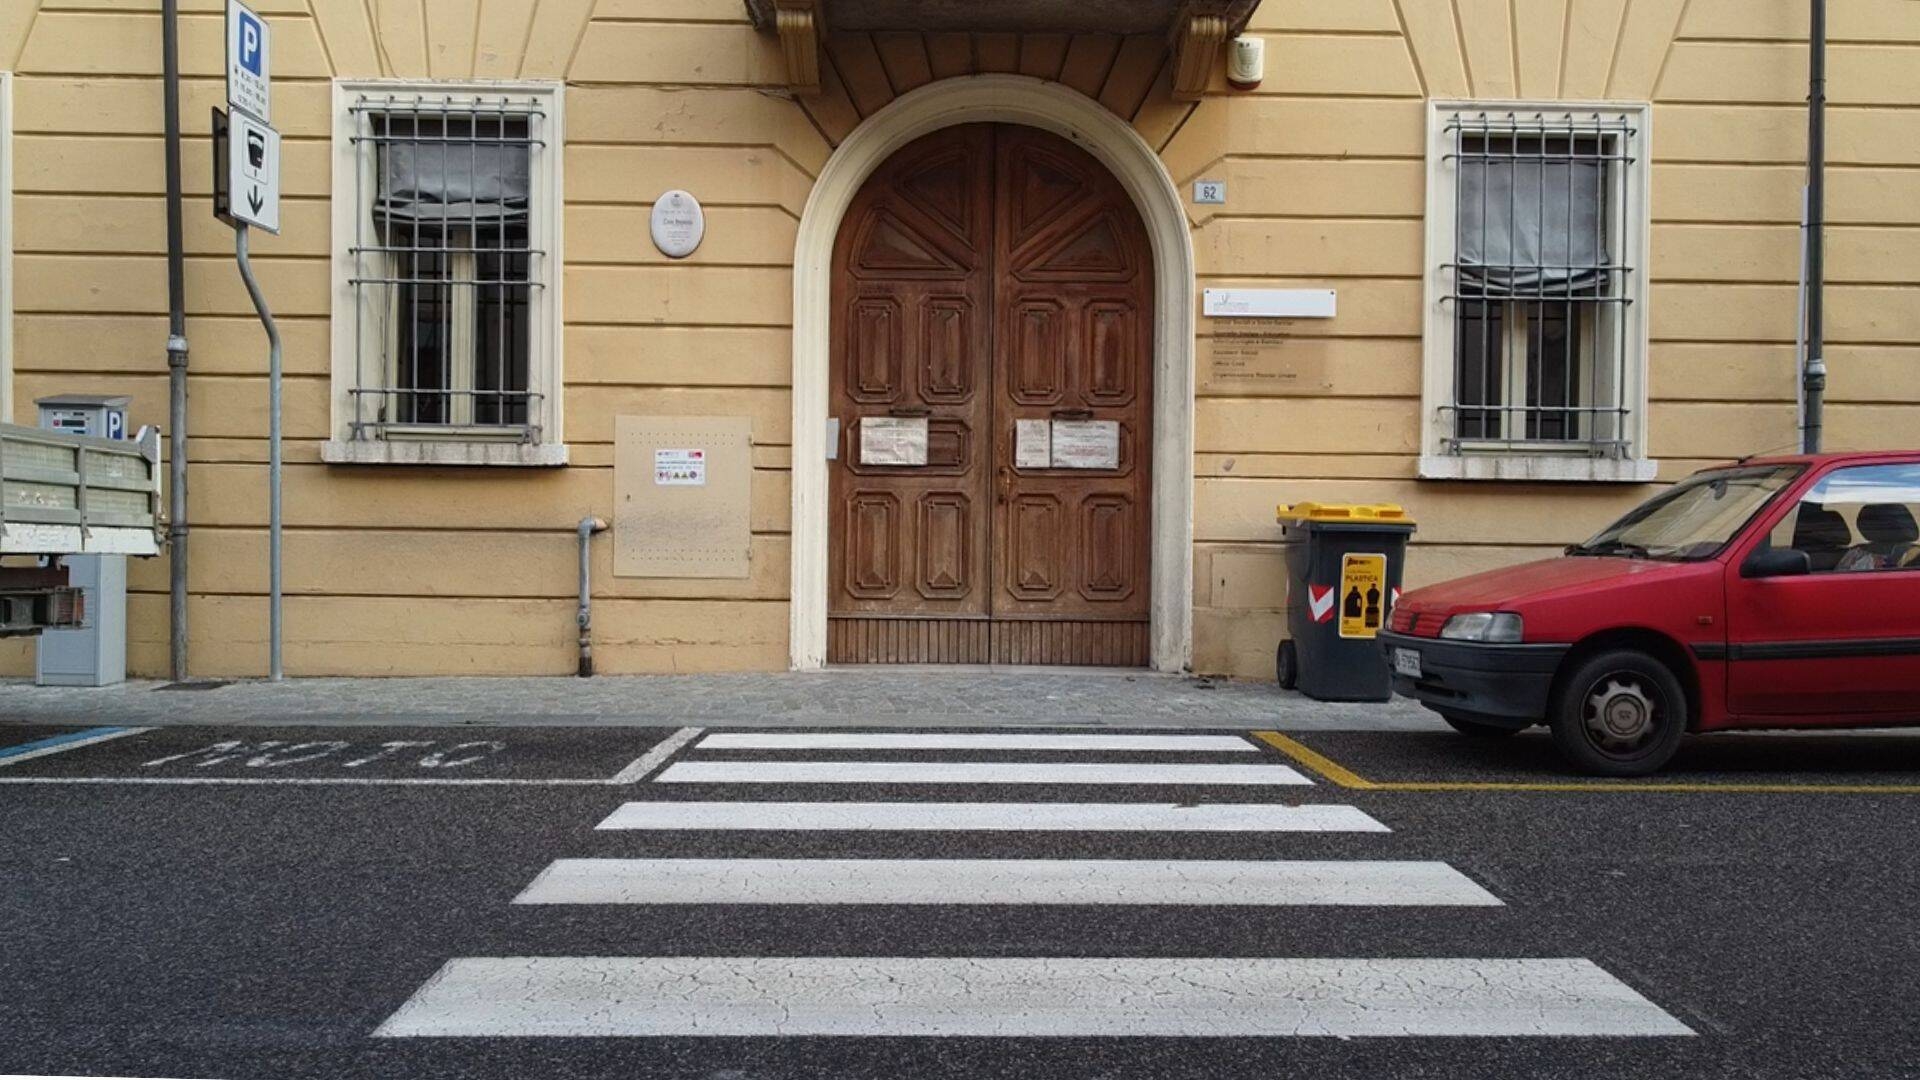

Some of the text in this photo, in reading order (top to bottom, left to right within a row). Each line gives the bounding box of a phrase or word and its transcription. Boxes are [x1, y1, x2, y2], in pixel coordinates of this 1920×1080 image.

[244, 22, 257, 62] P
[1204, 187, 1216, 199] 62
[109, 411, 120, 439] P
[1345, 574, 1378, 583] PLASTICA
[140, 739, 507, 768] MOTO
